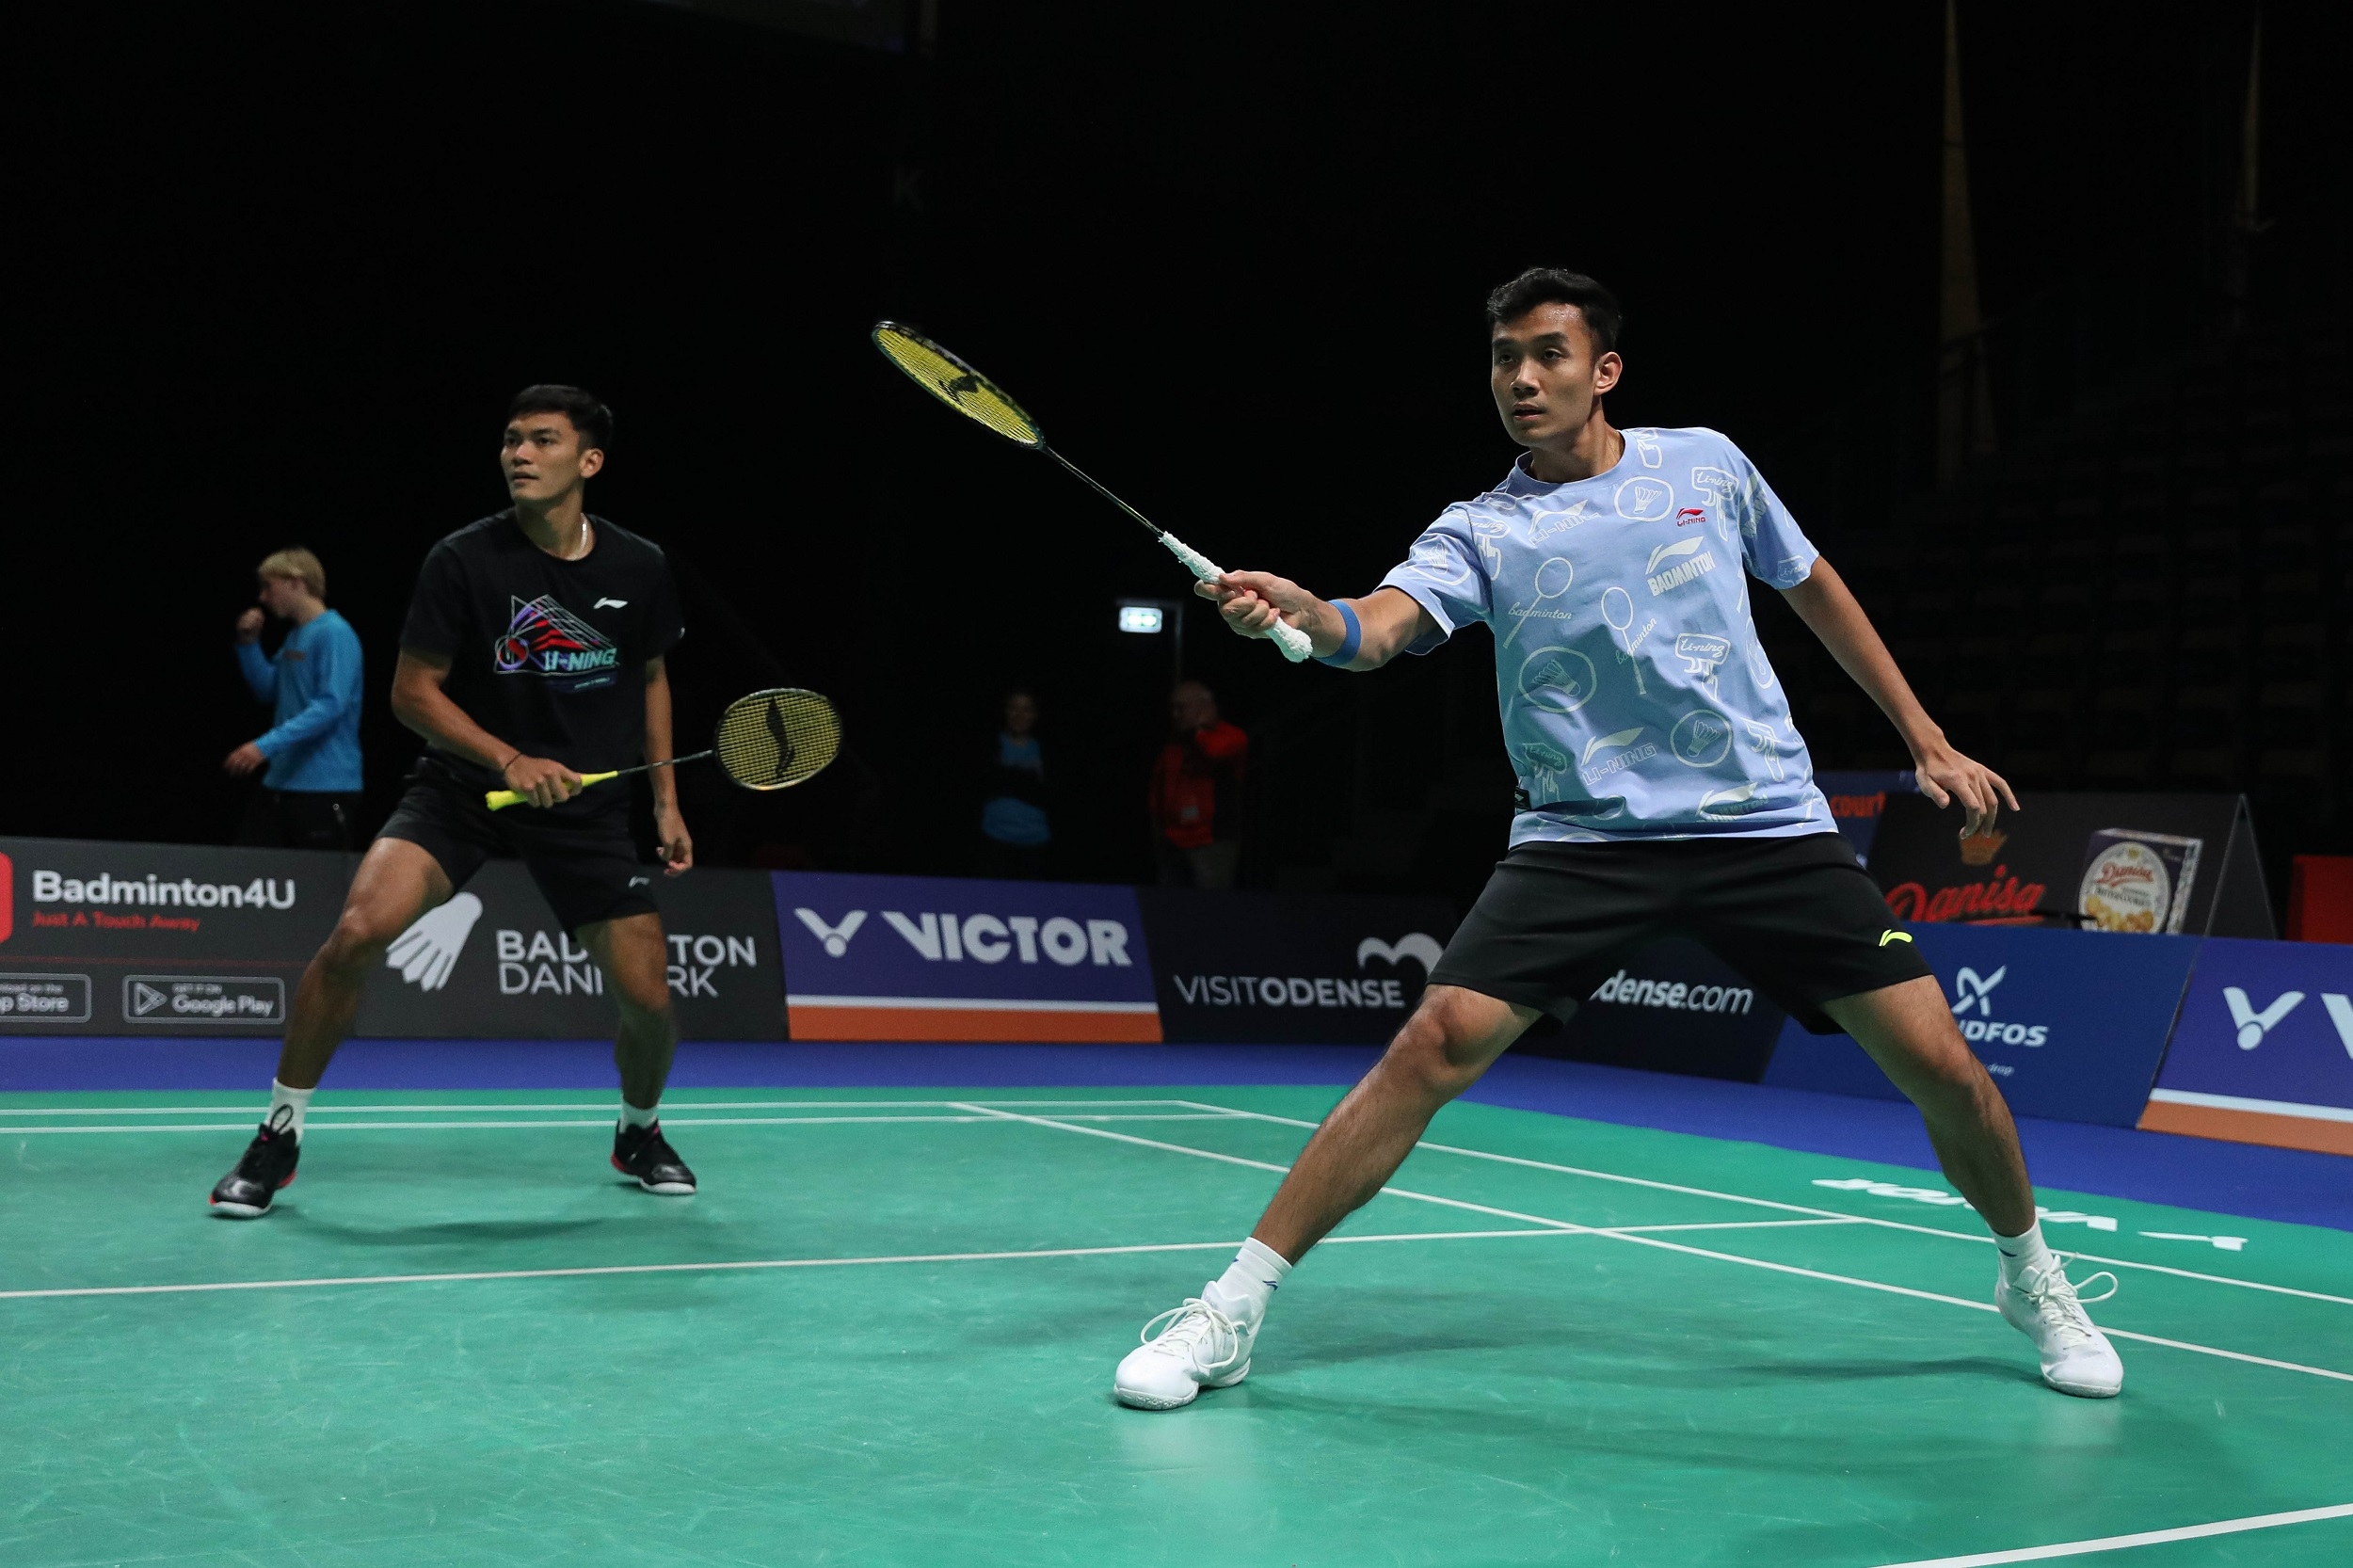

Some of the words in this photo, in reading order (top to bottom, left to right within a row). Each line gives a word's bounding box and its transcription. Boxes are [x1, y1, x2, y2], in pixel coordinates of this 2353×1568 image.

[1676, 517, 1706, 527] LI-NING
[1647, 551, 1716, 597] BADMINTON
[1581, 743, 1657, 786] LI-NING
[32, 869, 296, 910] Badminton4U
[72, 911, 88, 927] A
[496, 929, 757, 967] BADTON
[881, 910, 1133, 967] VICTOR
[17, 992, 70, 1013] Store
[171, 994, 236, 1017] Google
[237, 995, 275, 1017] Play
[1173, 974, 1406, 1009] VISITODENSE
[1594, 968, 1754, 1016] dense.com
[1959, 1019, 2050, 1048] DFOS
